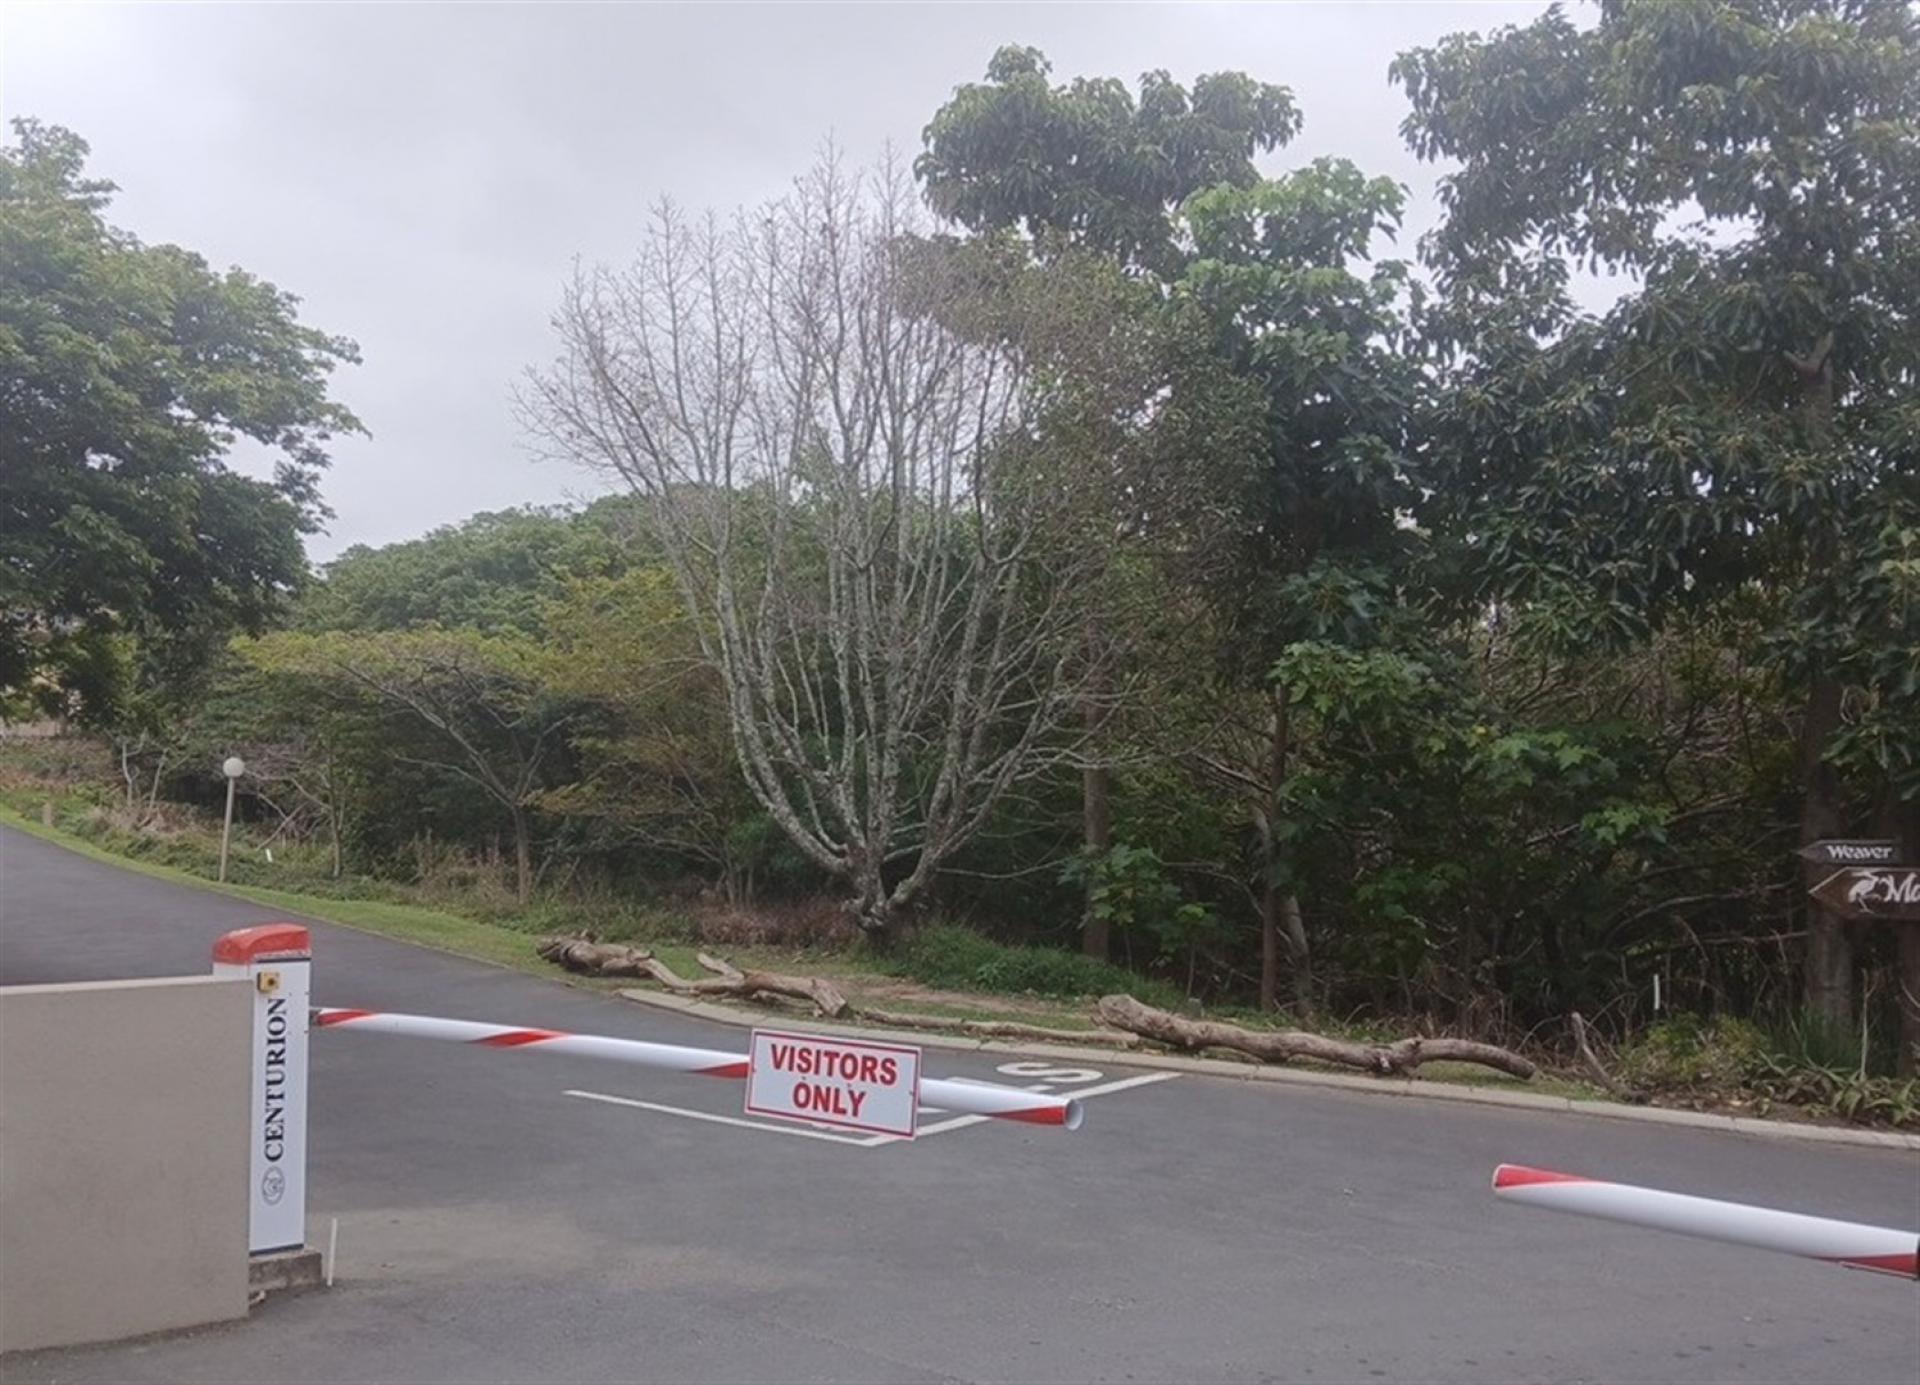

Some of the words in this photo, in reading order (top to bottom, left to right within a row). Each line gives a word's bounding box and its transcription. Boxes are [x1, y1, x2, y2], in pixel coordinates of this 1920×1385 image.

[1826, 845, 1892, 859] Weaver
[264, 998, 287, 1163] CENTURION
[770, 1043, 897, 1085] VISITORS
[793, 1082, 866, 1117] ONLY
